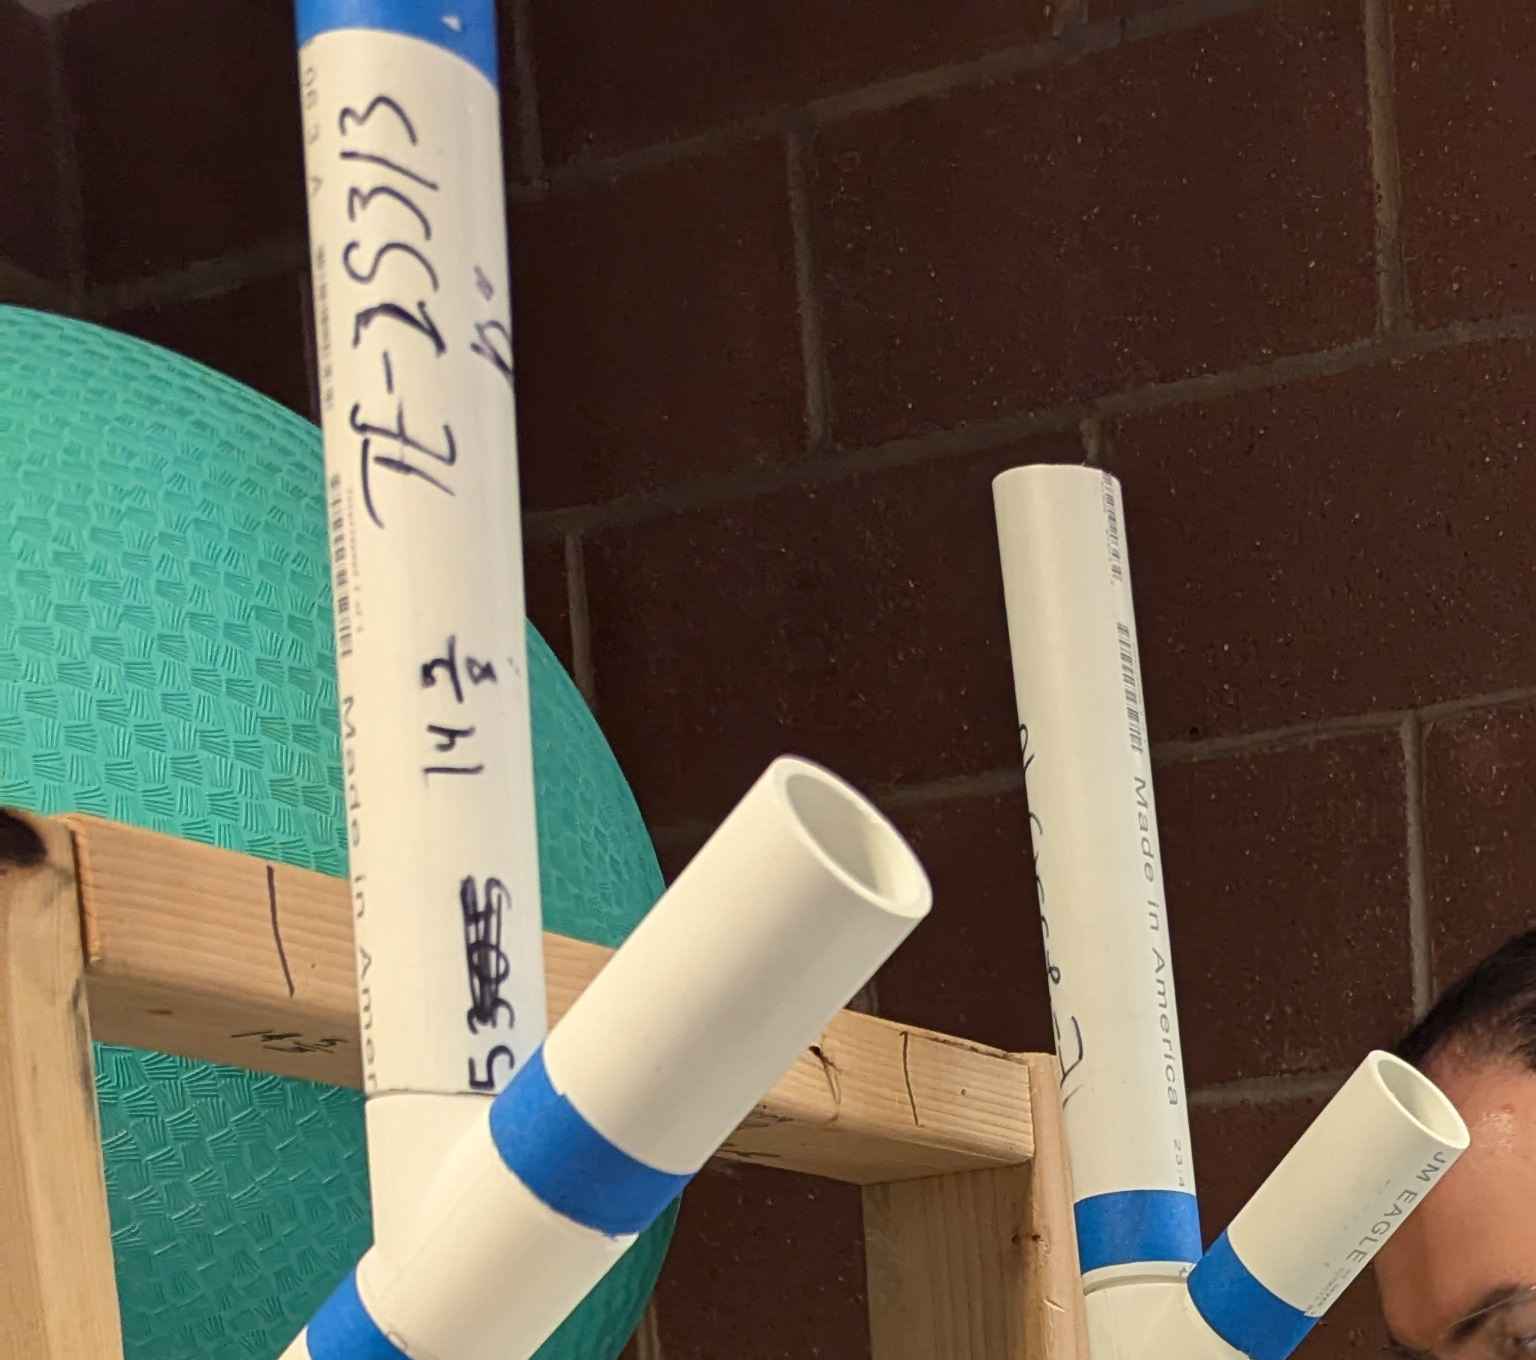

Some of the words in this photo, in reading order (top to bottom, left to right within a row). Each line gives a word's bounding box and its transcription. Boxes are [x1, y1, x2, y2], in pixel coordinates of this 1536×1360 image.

[1131, 776, 1159, 884] Made
[1145, 900, 1163, 934] in
[1149, 946, 1183, 1108] America
[1415, 1149, 1448, 1192] JM
[1346, 1186, 1420, 1265] EAGLE
